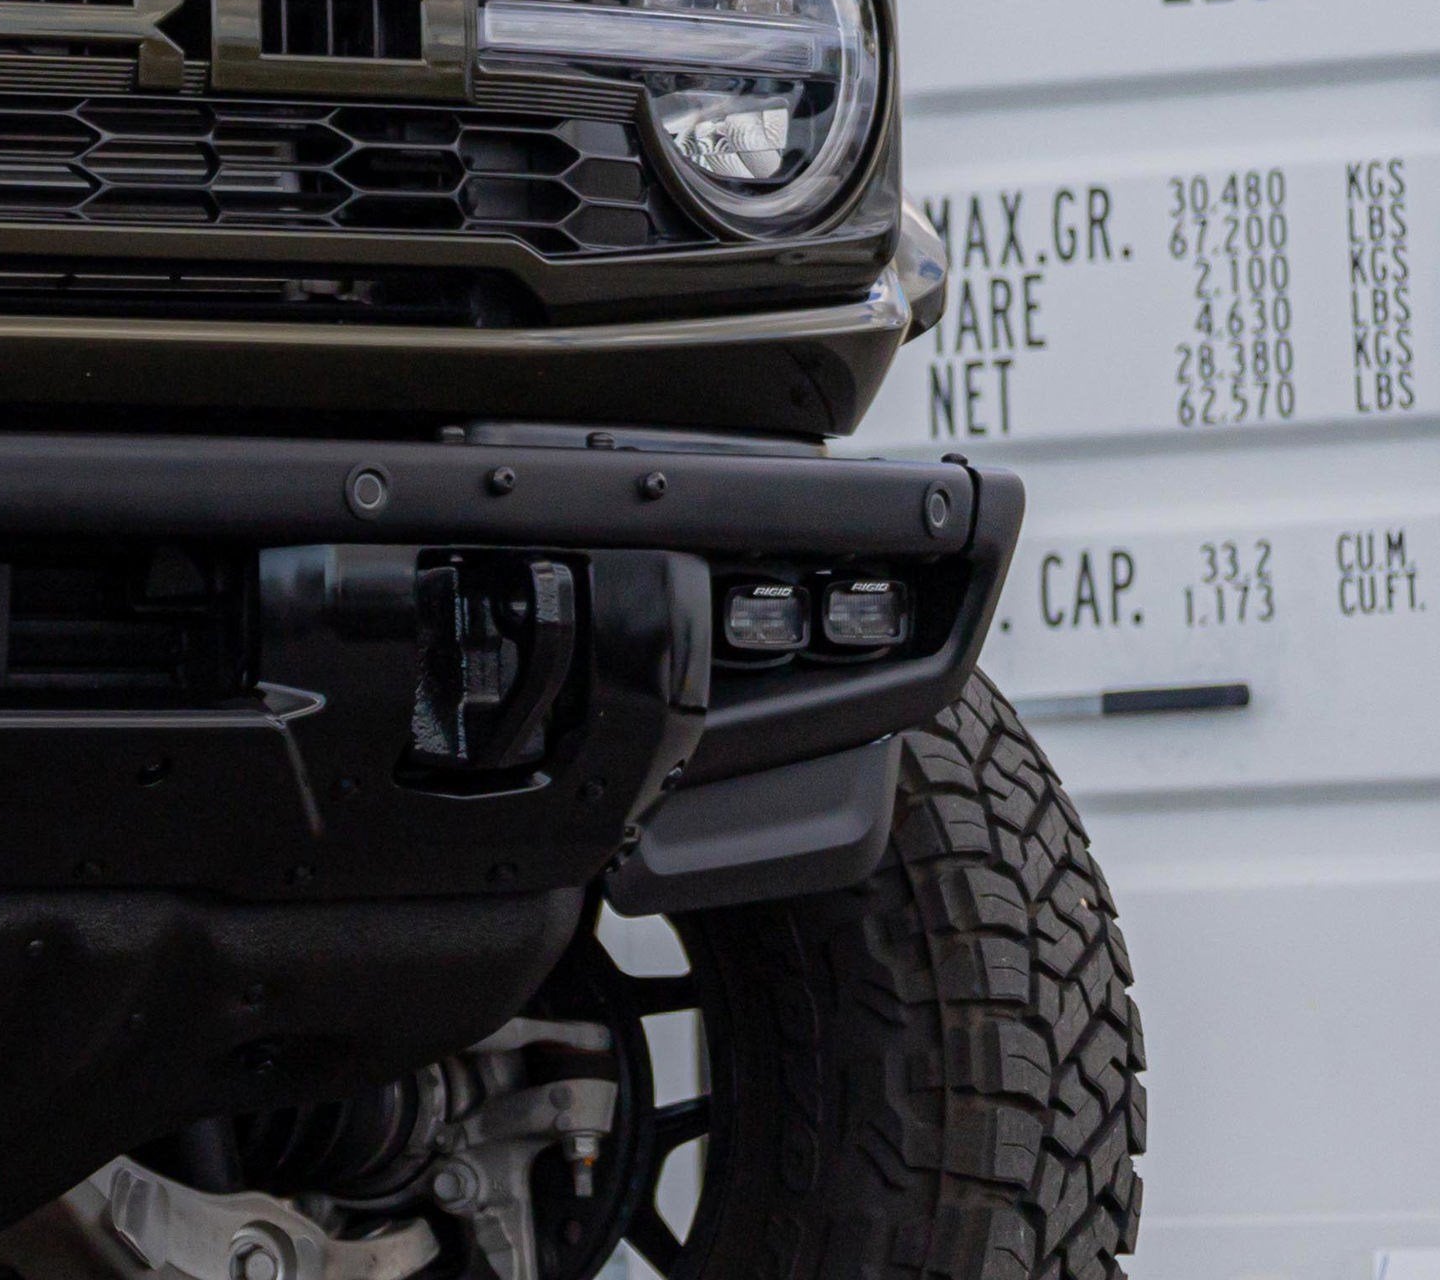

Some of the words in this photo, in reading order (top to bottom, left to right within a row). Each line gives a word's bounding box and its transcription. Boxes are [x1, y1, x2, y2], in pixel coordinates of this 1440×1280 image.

[1168, 168, 1287, 218] 30.480
[1344, 158, 1406, 201] KGS
[1169, 212, 1288, 260] 67.200
[1347, 201, 1408, 244] LBS
[1194, 254, 1290, 300] 2.100
[1350, 244, 1410, 285] KGS
[1352, 286, 1412, 327] LBS
[1354, 327, 1414, 369] KGS
[929, 358, 1014, 439] NET
[1355, 369, 1416, 412] LBS
[752, 585, 794, 597] RIGID
[850, 581, 890, 593] RIGID
